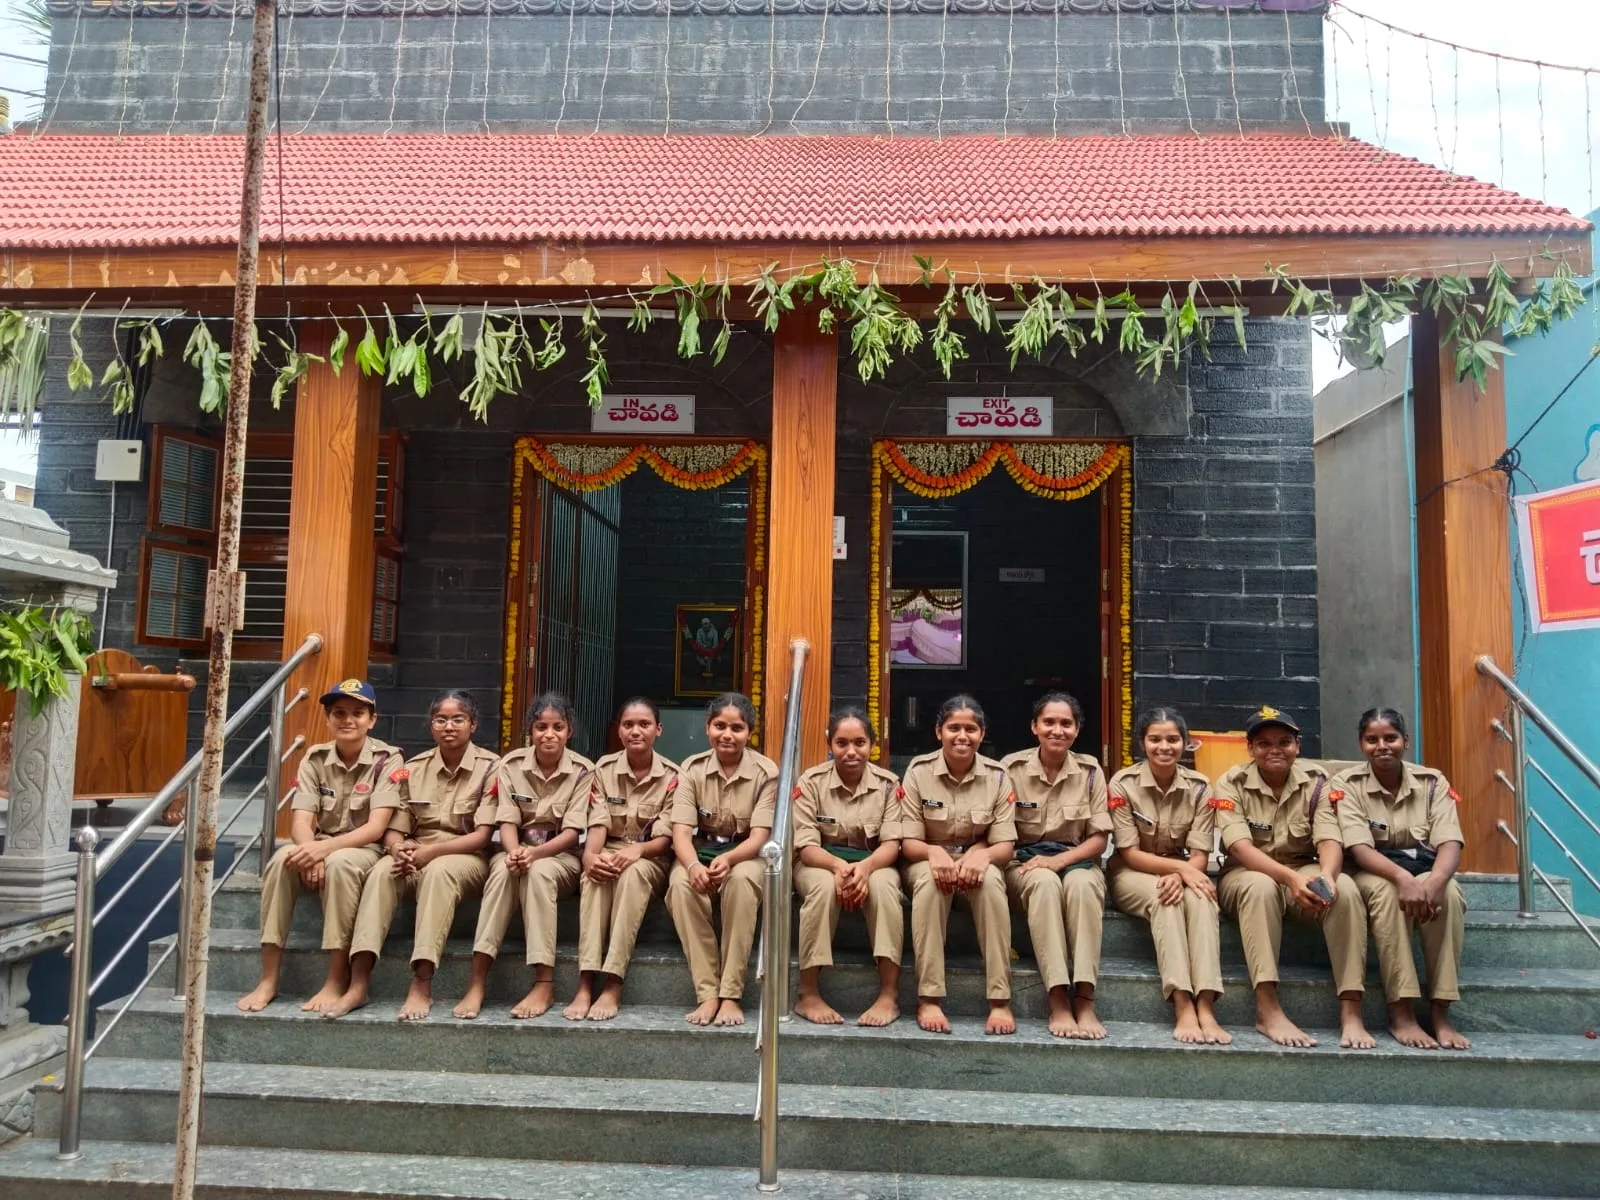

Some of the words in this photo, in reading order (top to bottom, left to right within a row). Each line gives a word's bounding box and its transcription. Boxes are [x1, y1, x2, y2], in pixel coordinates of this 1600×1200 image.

[623, 399, 639, 408] IN
[983, 398, 1010, 408] EXIT
[608, 403, 679, 422] చావడి
[955, 406, 1042, 427] చావడి
